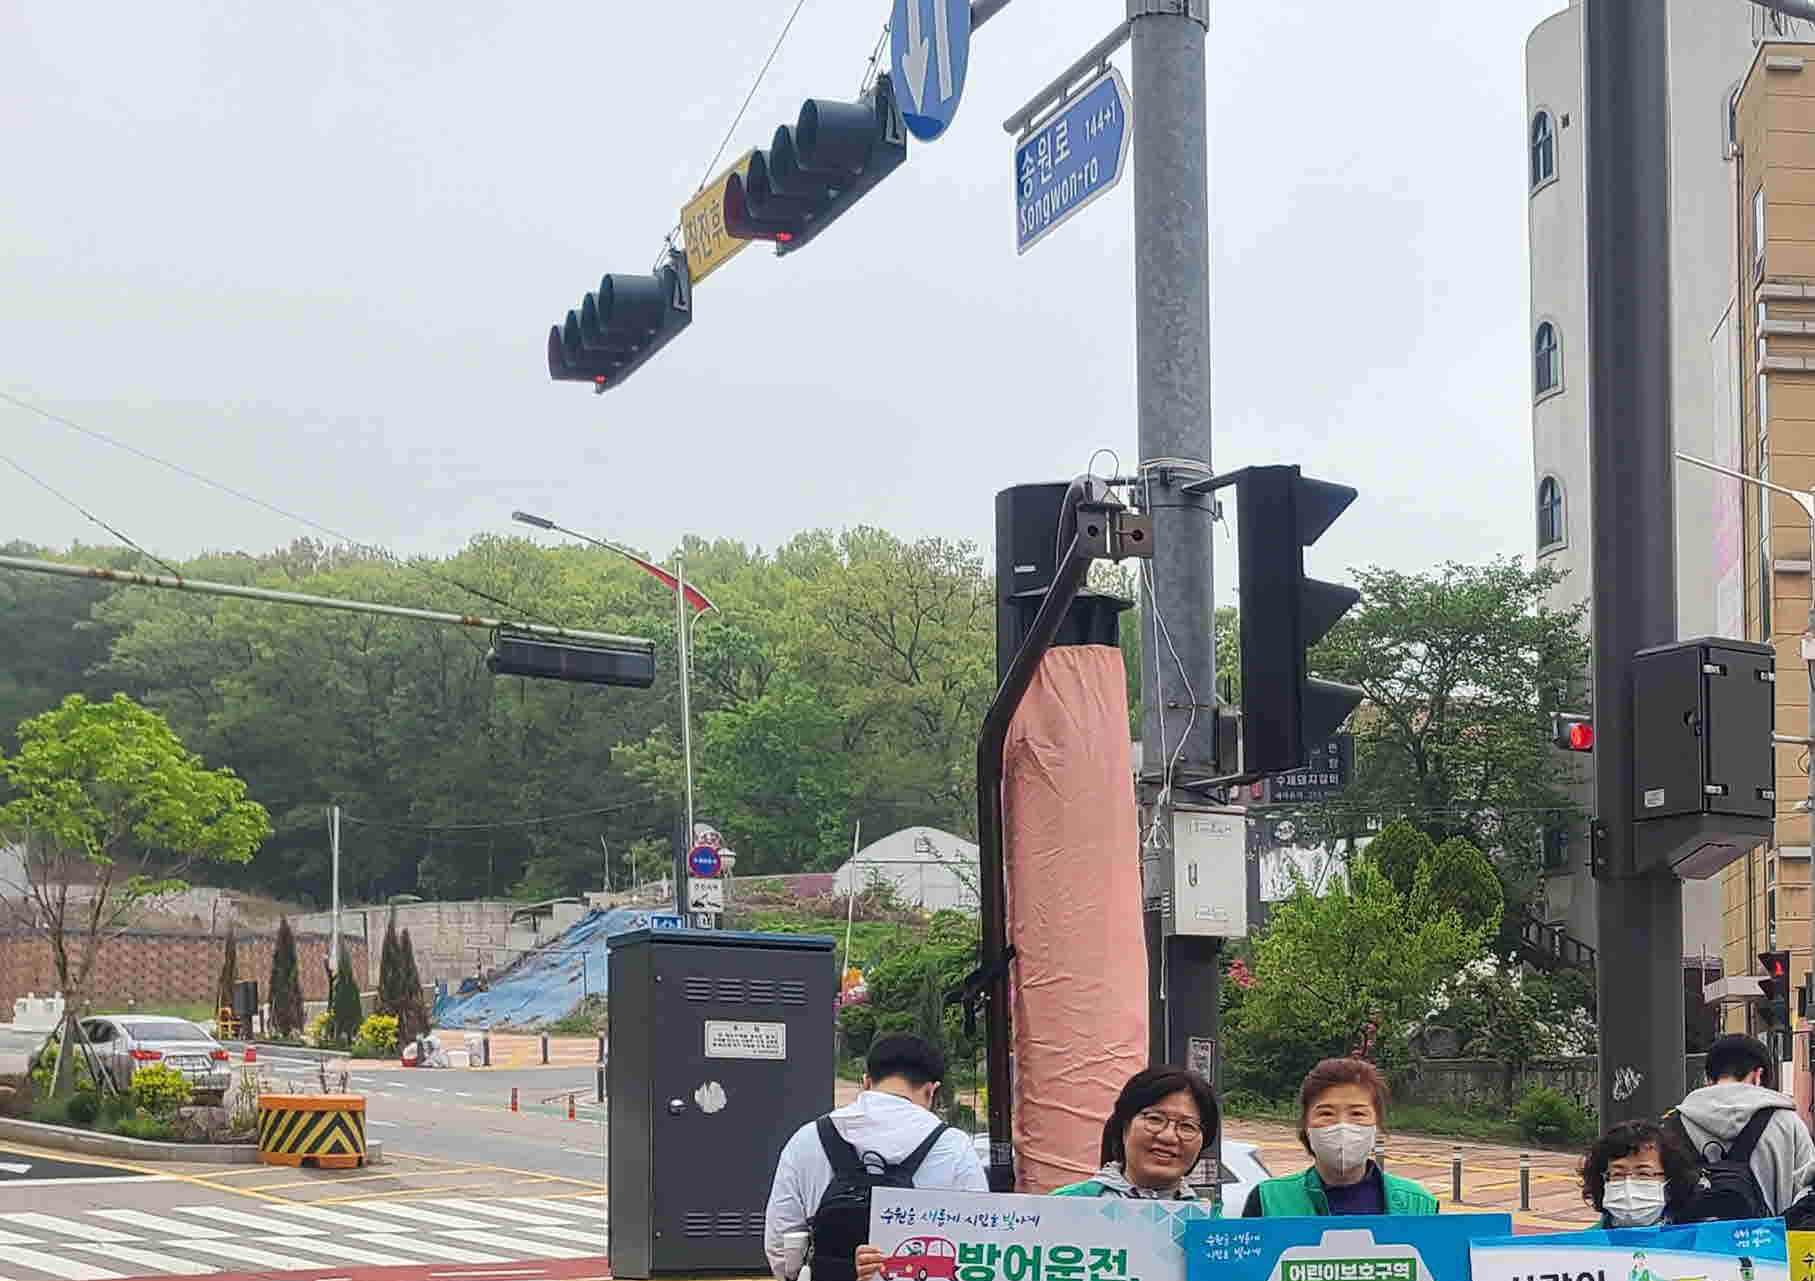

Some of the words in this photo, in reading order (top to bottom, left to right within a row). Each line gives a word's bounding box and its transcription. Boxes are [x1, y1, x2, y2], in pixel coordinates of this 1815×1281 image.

[1022, 120, 1072, 200] 송원로
[1022, 157, 1099, 234] Songwon-ro
[880, 1206, 916, 1226] 수원을
[920, 1207, 960, 1227] 새롭게
[965, 1212, 998, 1227] 시민을
[1289, 1261, 1410, 1281] 어린이보호구역
